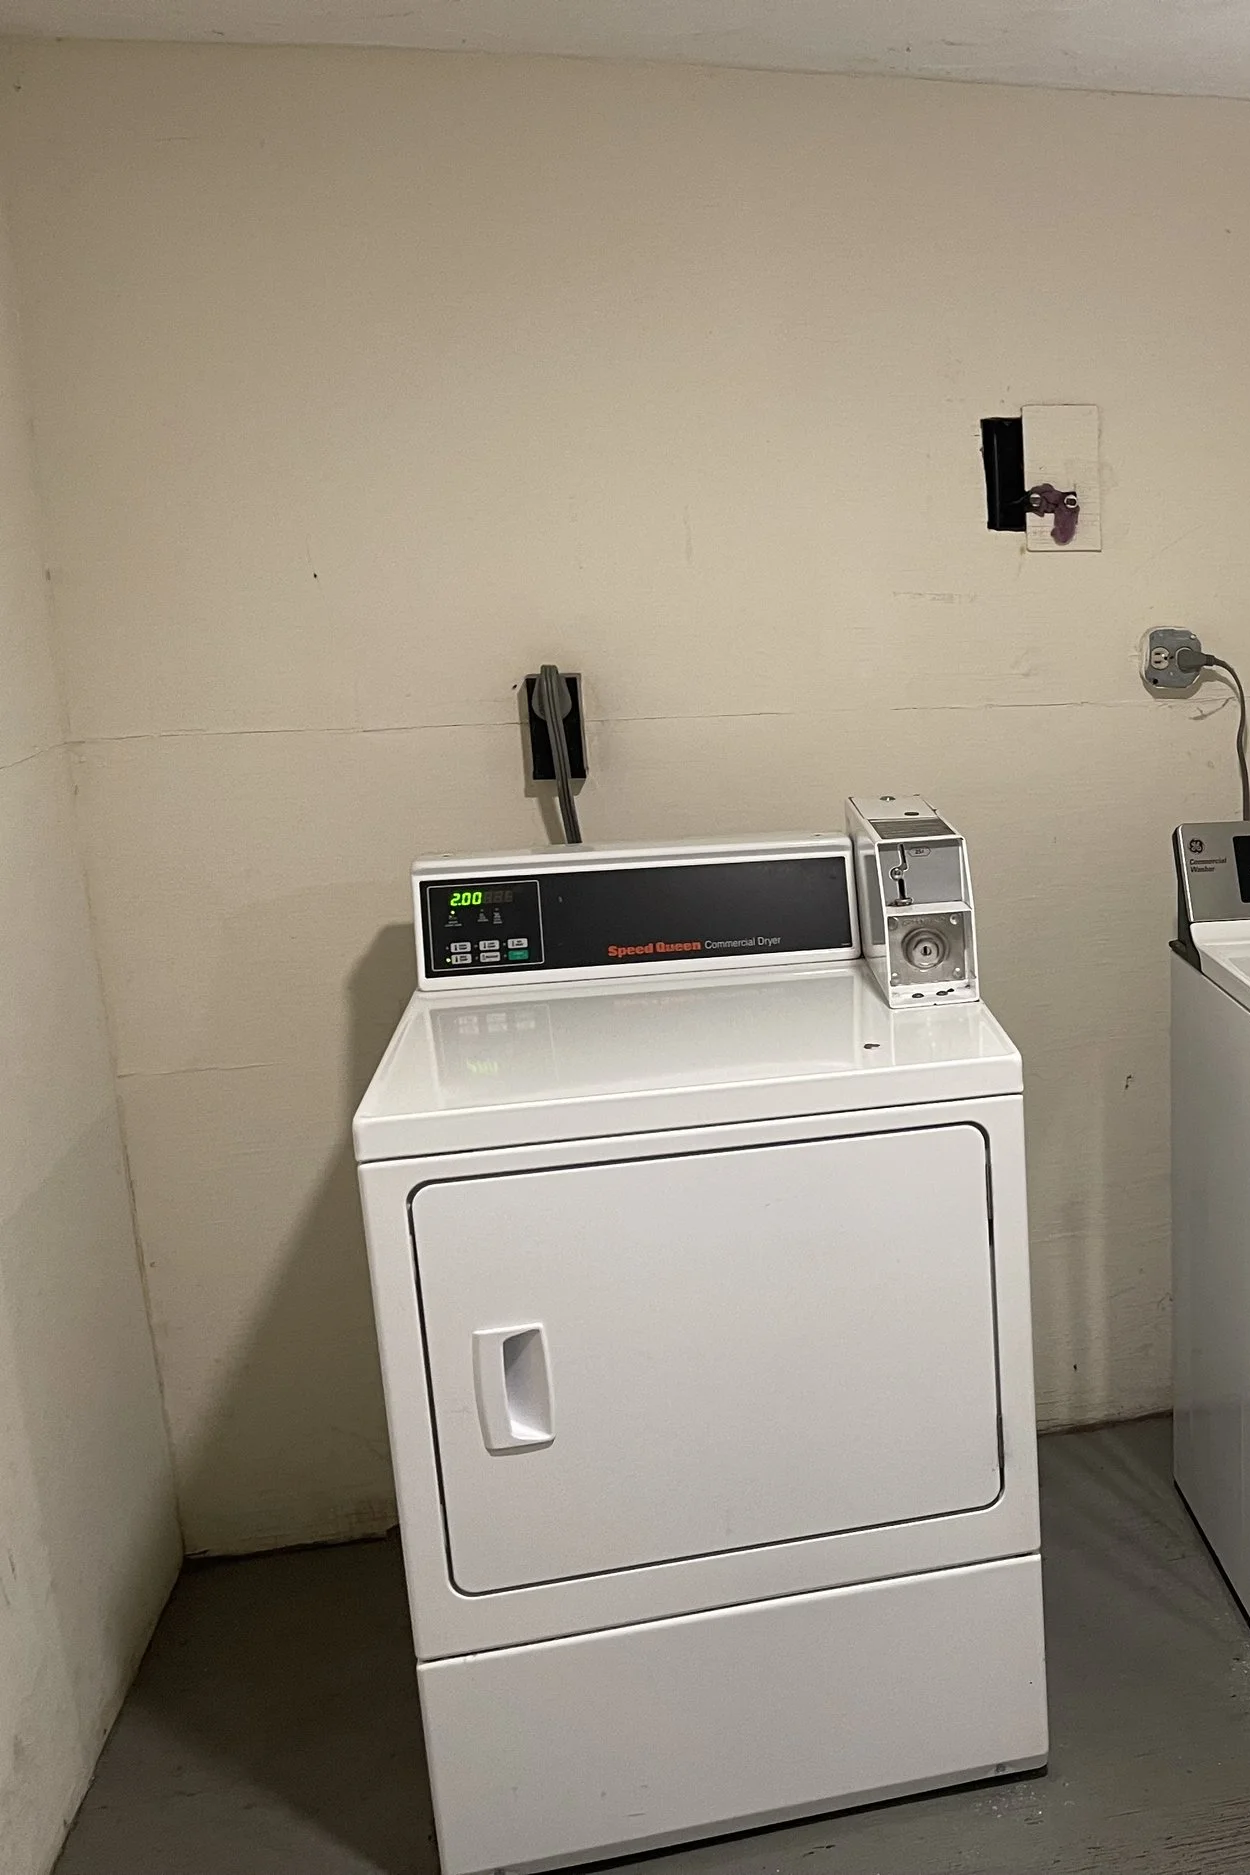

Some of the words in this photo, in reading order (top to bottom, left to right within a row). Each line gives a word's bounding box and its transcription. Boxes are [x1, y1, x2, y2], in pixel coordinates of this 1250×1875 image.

[450, 891, 483, 907] 2.00
[607, 942, 654, 958] Speed
[656, 940, 702, 953] Queen
[704, 937, 756, 950] Commercial
[757, 936, 782, 947] Dryer
